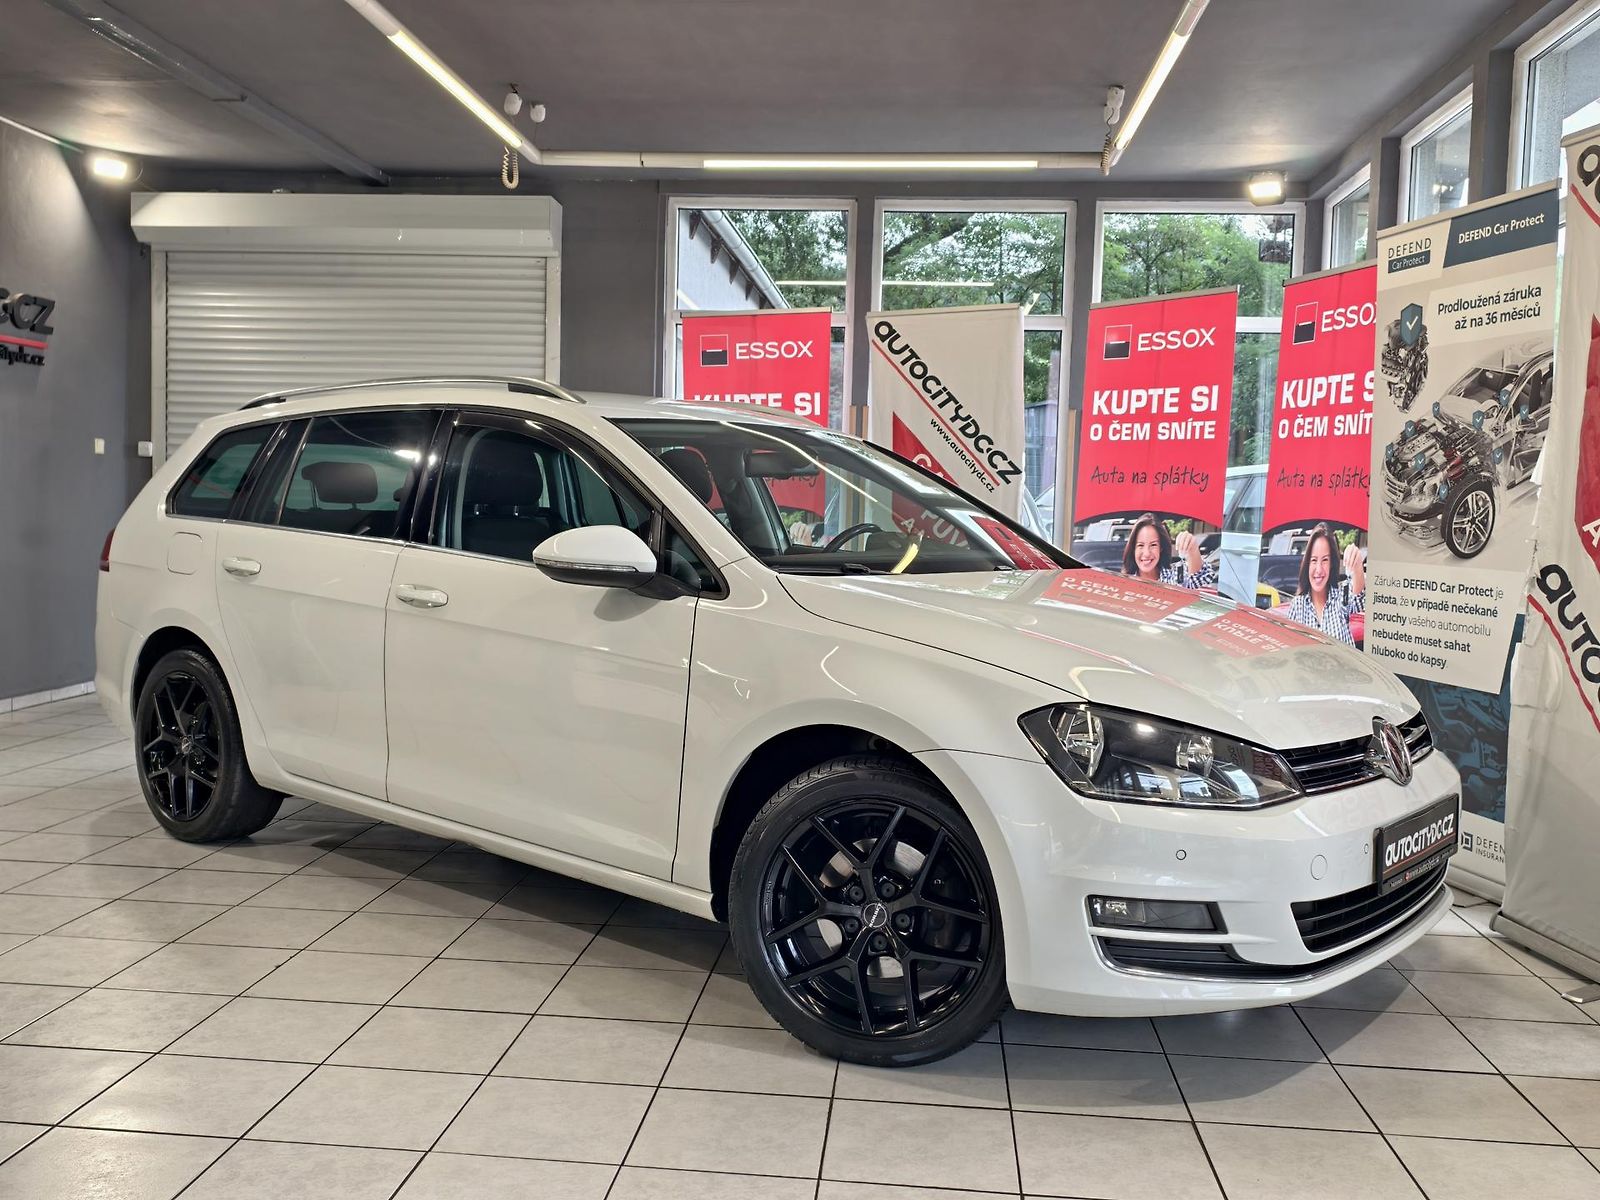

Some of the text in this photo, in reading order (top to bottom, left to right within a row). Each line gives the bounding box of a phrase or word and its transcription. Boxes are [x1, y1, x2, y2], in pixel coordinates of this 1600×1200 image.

[1458, 213, 1545, 244] DEFEND Car Protect
[1388, 237, 1432, 259] DEFEND
[1391, 255, 1425, 270] Car Protect
[1437, 285, 1542, 315] Prodloužená záruka
[1321, 302, 1377, 332] ESSO
[1454, 301, 1541, 330] až na 36 měsíců
[735, 340, 814, 360] ESSOX
[1137, 327, 1216, 352] ESSOX
[793, 391, 821, 416] SI
[1092, 384, 1220, 416] KUPTE SI
[1281, 373, 1355, 409] KUPTE
[1089, 418, 1216, 441] O ČEM SNÍTE
[1278, 418, 1289, 439] O
[1293, 413, 1329, 438] ČEM
[930, 418, 995, 493] www.autocitydc.cz
[1091, 465, 1209, 492] Auta na splátky
[1277, 467, 1305, 488] Auta
[1310, 473, 1323, 488] na
[1374, 575, 1504, 600] Záruka DEFEND Car Protect je
[1399, 596, 1409, 607] že
[1410, 599, 1416, 607] v
[1417, 598, 1449, 612] případě
[1451, 603, 1498, 618] nečekané
[1373, 611, 1491, 637] poruchy vašeho automobilu
[1371, 644, 1406, 660] hluboko
[1407, 651, 1419, 662] do
[1372, 628, 1471, 653] nebudete muset sahat
